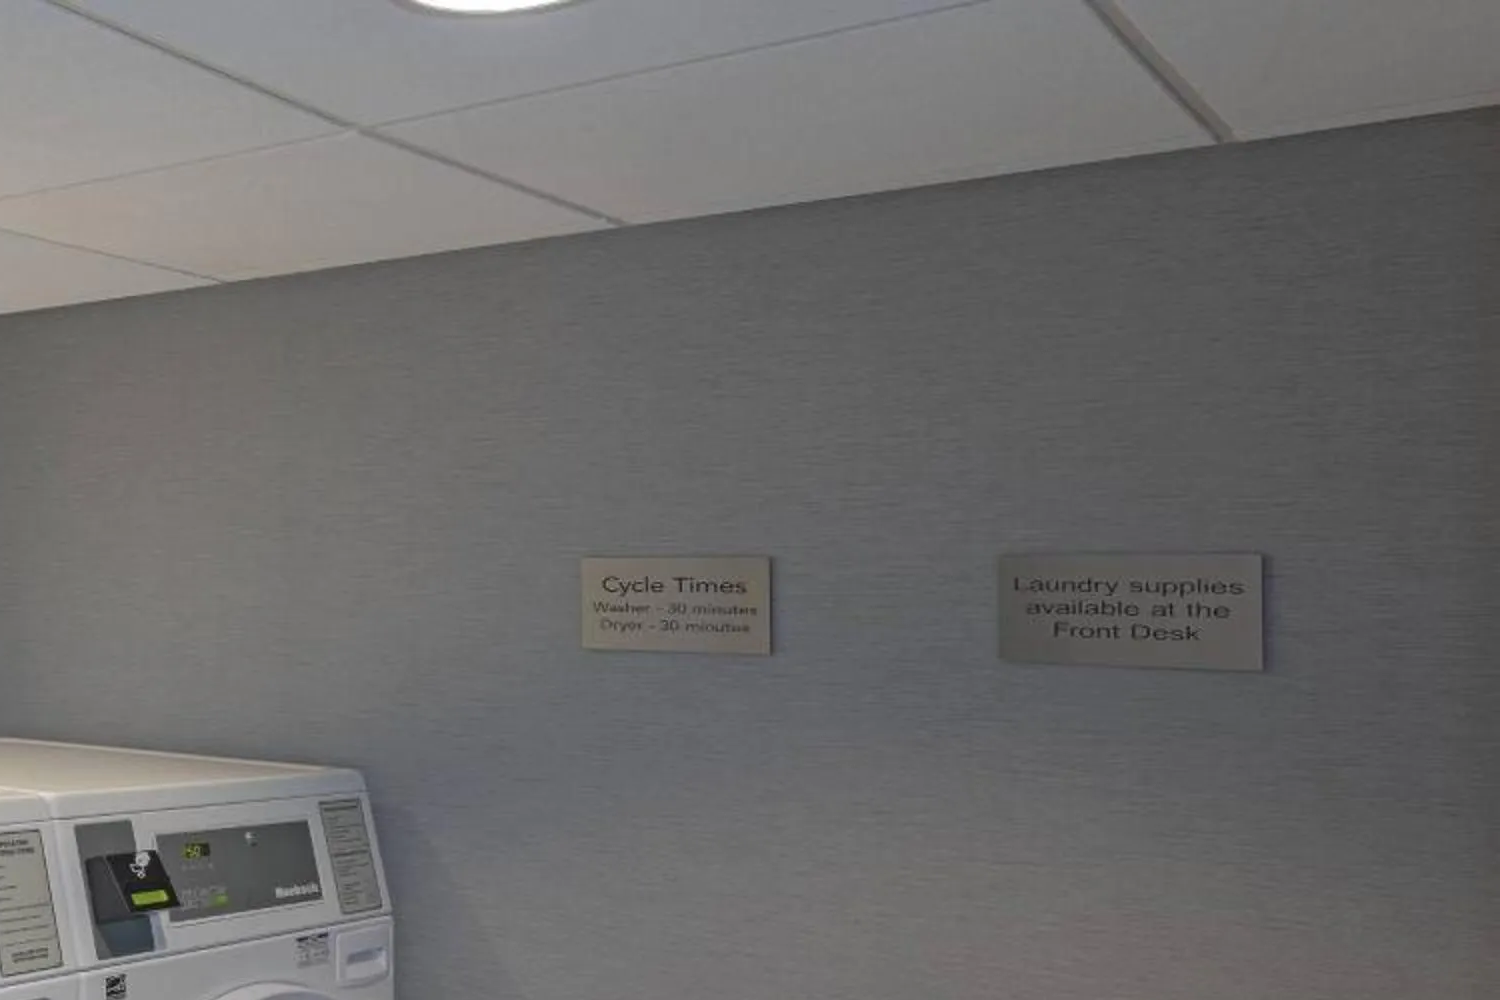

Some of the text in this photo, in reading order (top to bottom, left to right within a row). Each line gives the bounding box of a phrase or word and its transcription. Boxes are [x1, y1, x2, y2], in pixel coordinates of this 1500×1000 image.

[601, 575, 747, 597] Cycle Times
[1014, 577, 1246, 598] Laundry supplies
[593, 601, 651, 613] Washer
[692, 603, 757, 616] minutes
[1025, 601, 1231, 619] available at the
[600, 619, 642, 633] Dryer
[660, 619, 680, 633] 30
[685, 621, 750, 633] minutes
[1053, 621, 1202, 642] Front Desk
